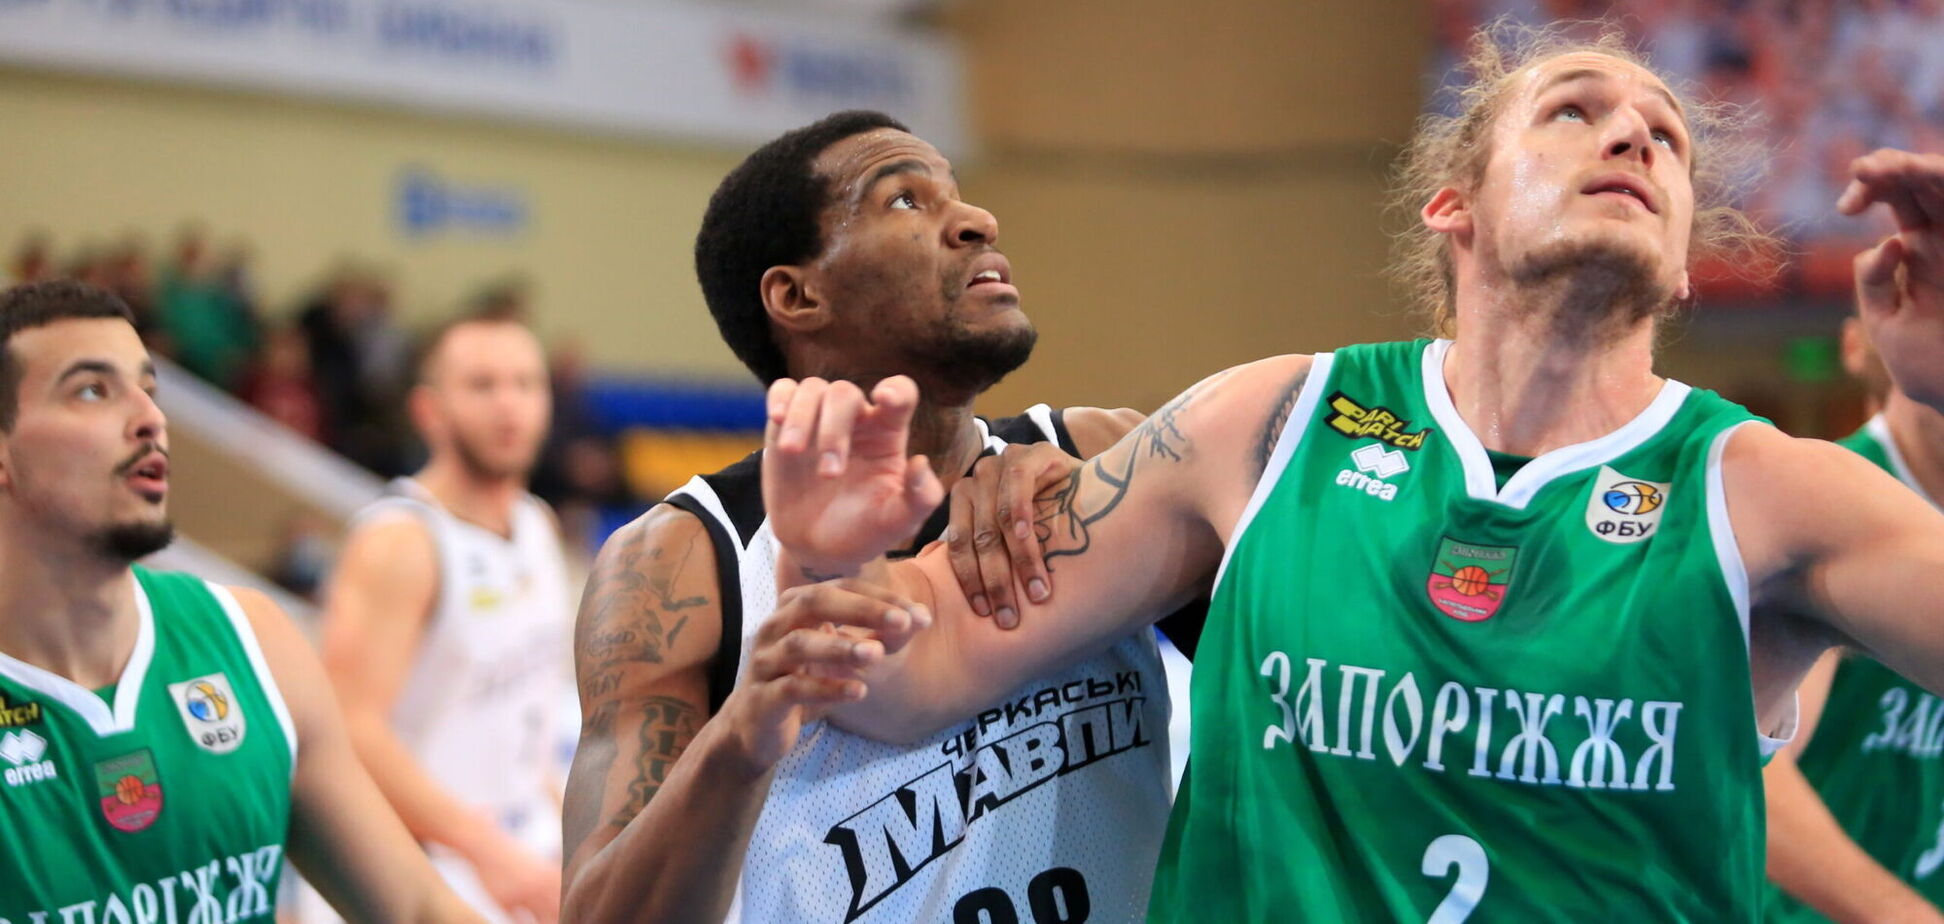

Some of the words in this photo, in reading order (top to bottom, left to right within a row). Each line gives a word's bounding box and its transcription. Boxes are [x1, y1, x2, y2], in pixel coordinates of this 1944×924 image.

[1331, 396, 1404, 430] PARI
[1330, 414, 1426, 448] MATCH
[1335, 468, 1398, 501] errea
[1596, 520, 1653, 536] ФБУ
[941, 671, 1142, 759] ЧЕРКАСЬКІ
[1260, 651, 1684, 791] ЗАПОРІЖЖЯ
[201, 724, 238, 747] ФБУ
[4, 759, 57, 787] errea
[823, 697, 1152, 924] МАВПИ
[1421, 834, 1489, 924] 2
